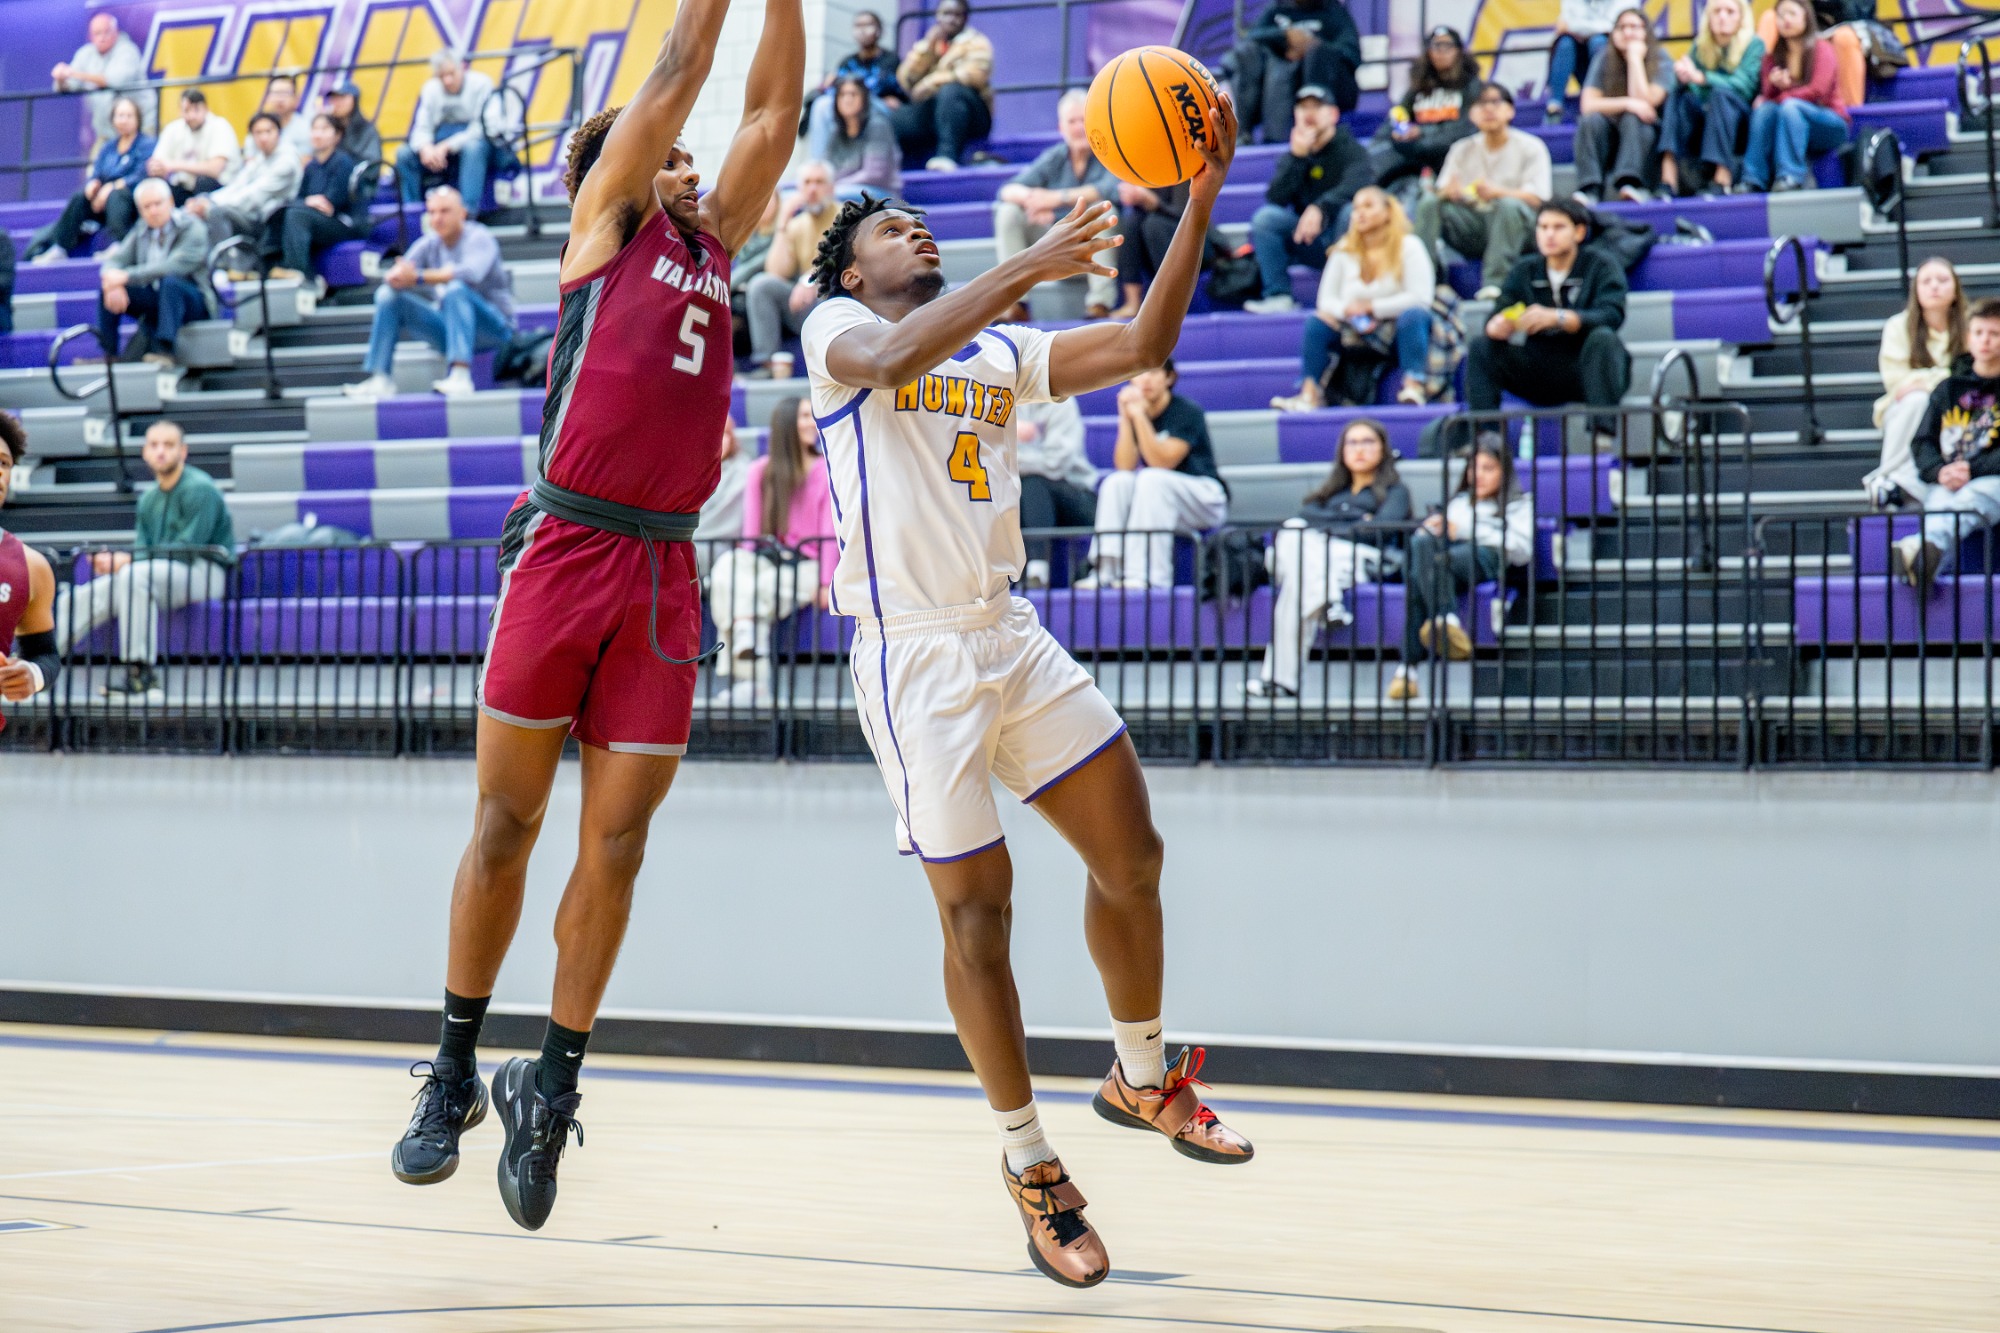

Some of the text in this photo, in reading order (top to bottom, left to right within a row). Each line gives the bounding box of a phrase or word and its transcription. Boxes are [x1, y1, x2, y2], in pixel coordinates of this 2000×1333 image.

[671, 302, 711, 377] 5
[894, 372, 1015, 428] HUNTER
[946, 430, 993, 502] 4
